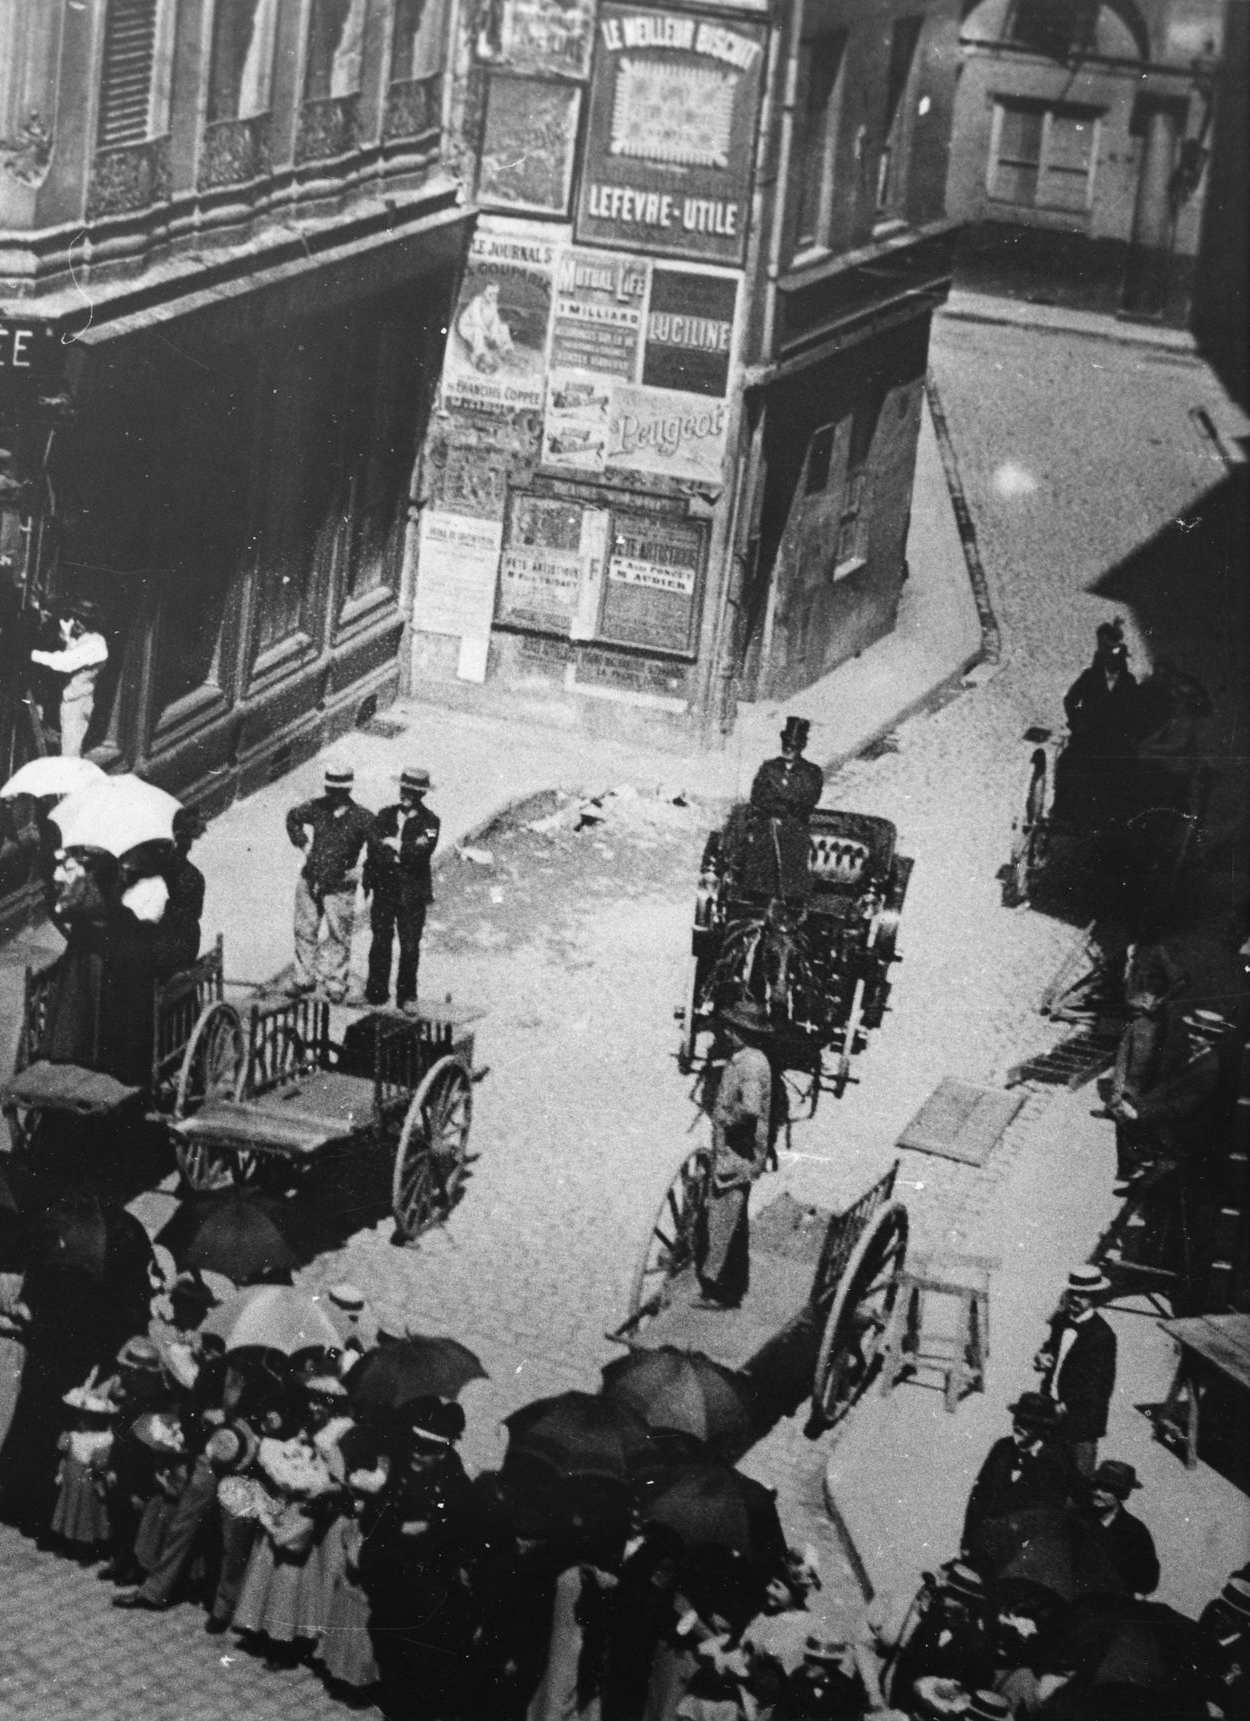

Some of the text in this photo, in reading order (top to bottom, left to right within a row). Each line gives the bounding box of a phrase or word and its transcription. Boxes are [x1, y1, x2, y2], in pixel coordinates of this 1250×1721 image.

[601, 18, 623, 51] LE
[622, 14, 696, 48] MEILLEUR
[488, 241, 542, 264] JOURNAL
[569, 303, 638, 324] MILLIARD
[649, 309, 732, 352] LUCILINE
